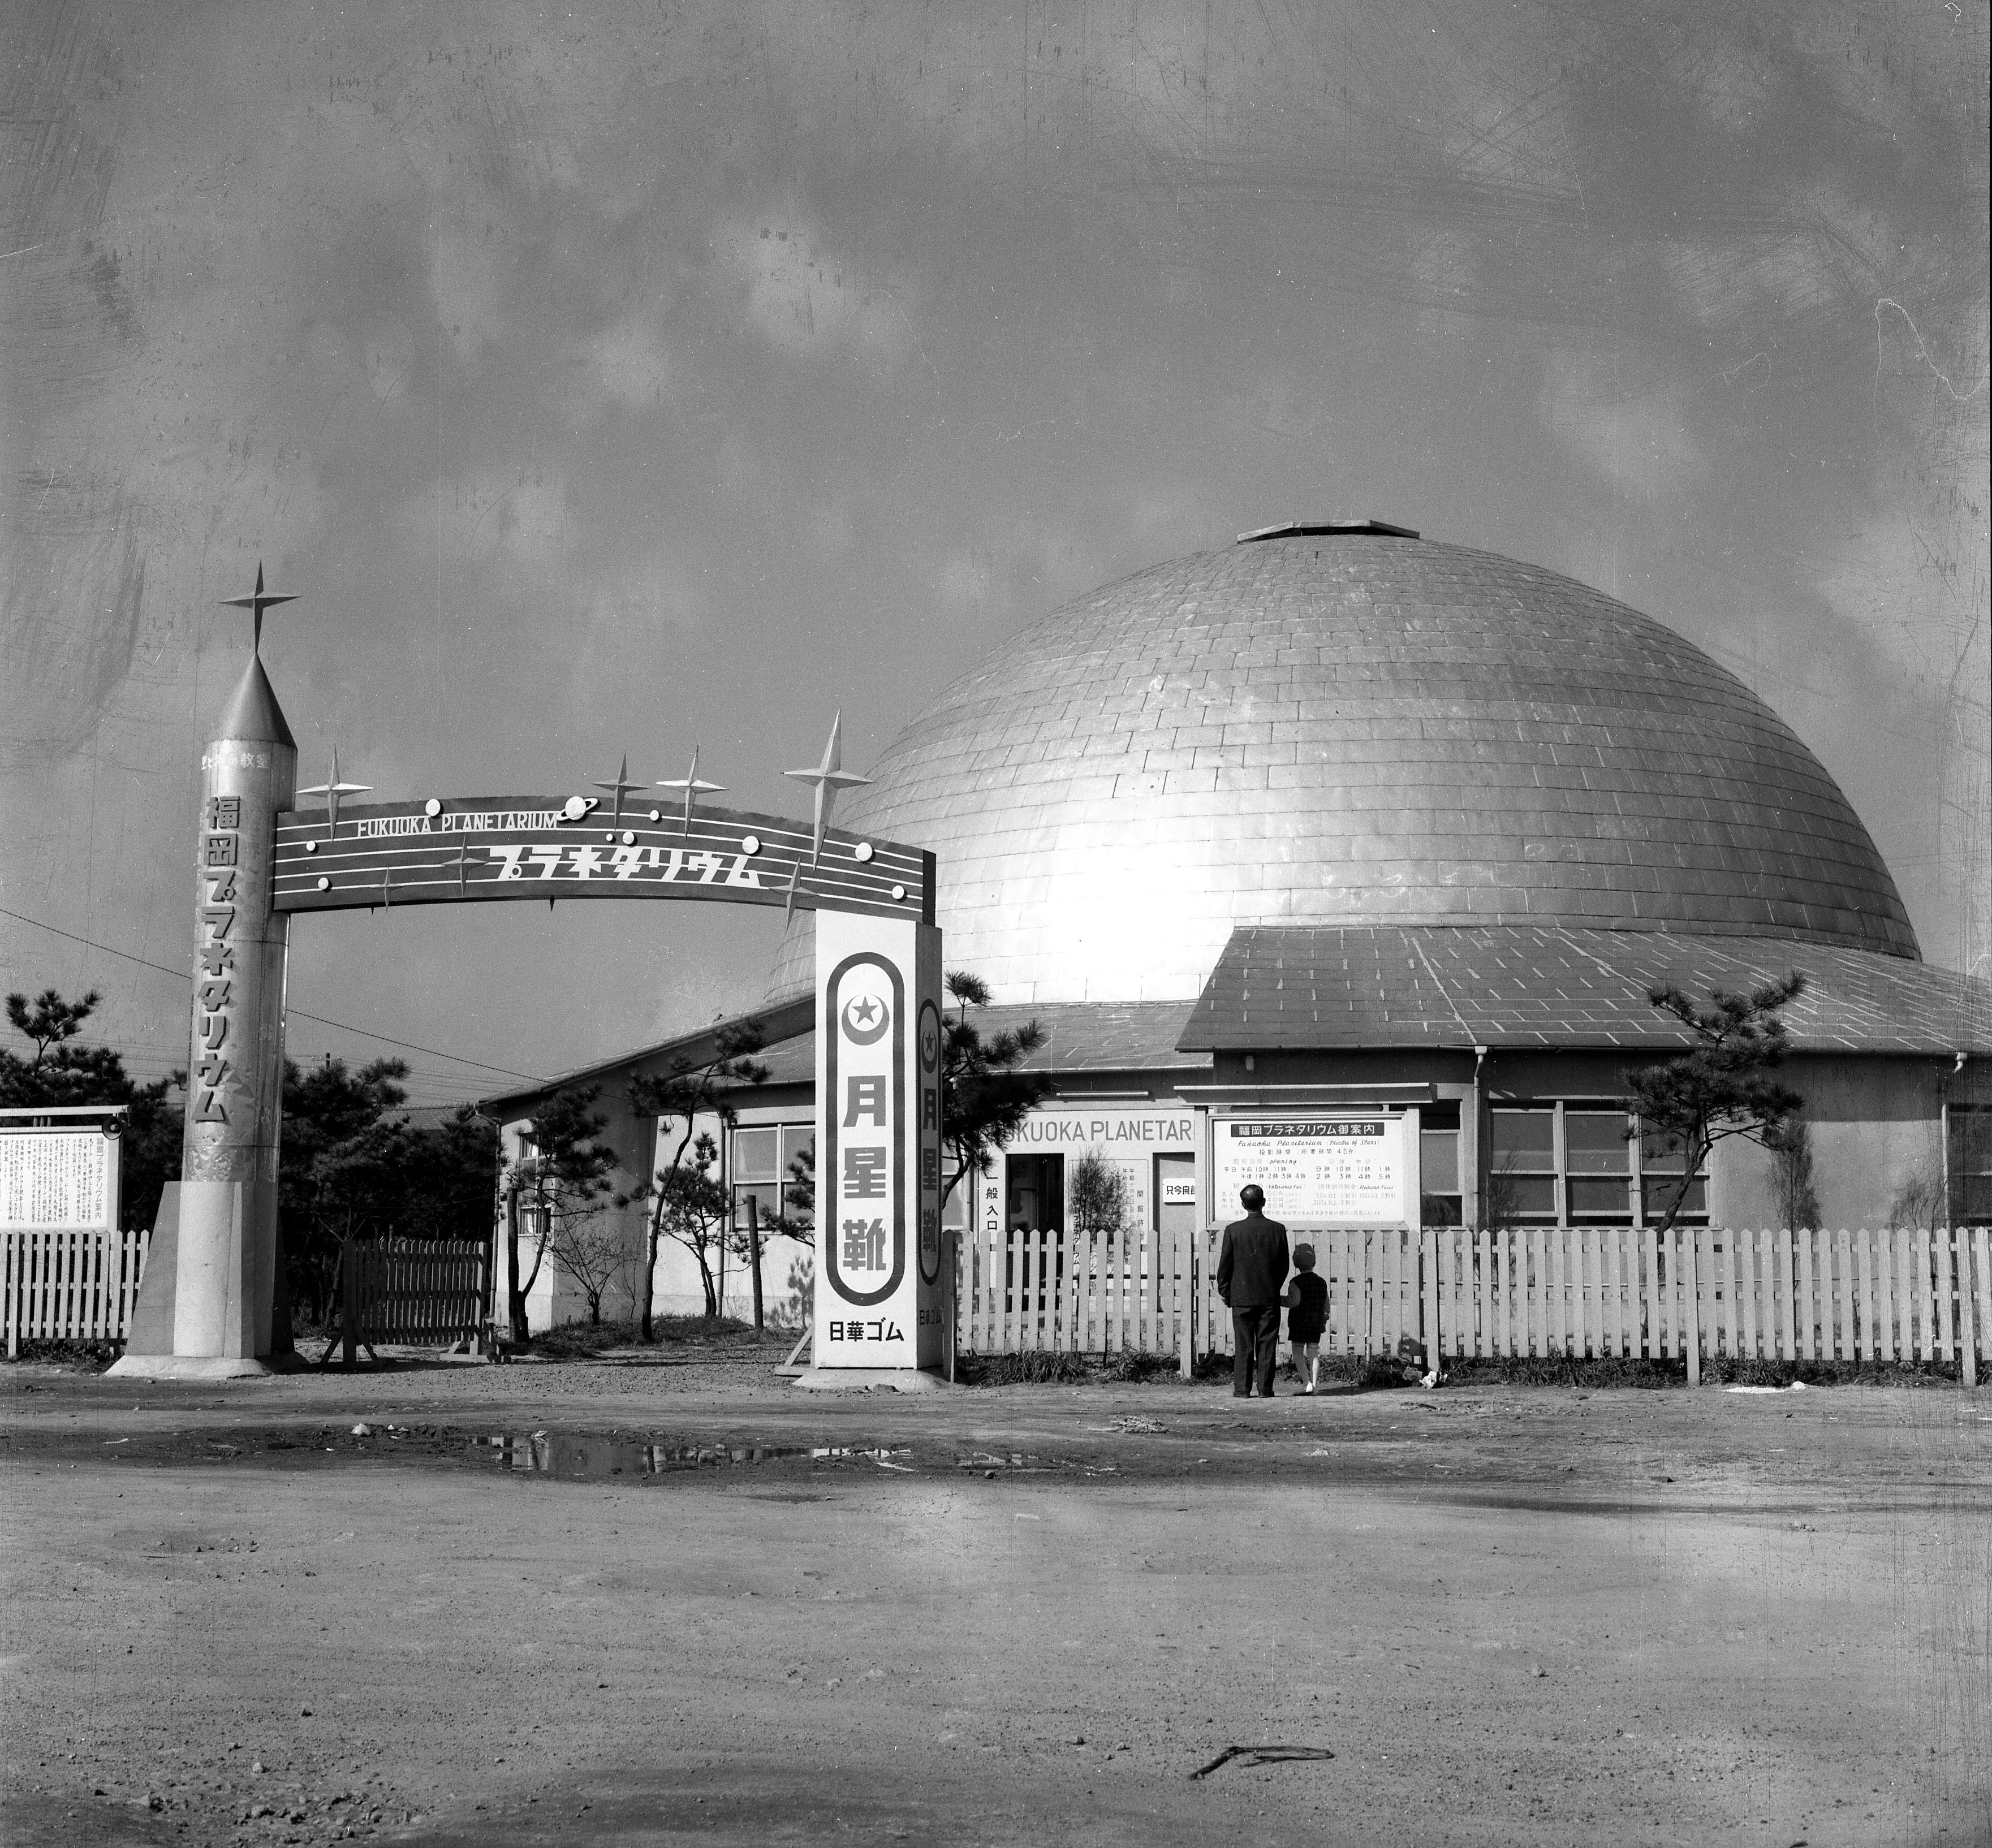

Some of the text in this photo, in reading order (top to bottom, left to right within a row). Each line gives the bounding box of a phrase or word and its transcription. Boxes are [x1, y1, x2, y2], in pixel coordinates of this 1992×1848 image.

[358, 811, 559, 838] FUKUOKA PLANETARIUM
[490, 845, 761, 888] プラネタリウム
[195, 796, 240, 1122] 福岡プラネタリウム
[1090, 1120, 1195, 1141] PLANETAR
[842, 1075, 887, 1271] 月星靴
[922, 1088, 937, 1254] 月星靴
[986, 1176, 998, 1231] 一般入口
[830, 1316, 904, 1342] 日華ゴム
